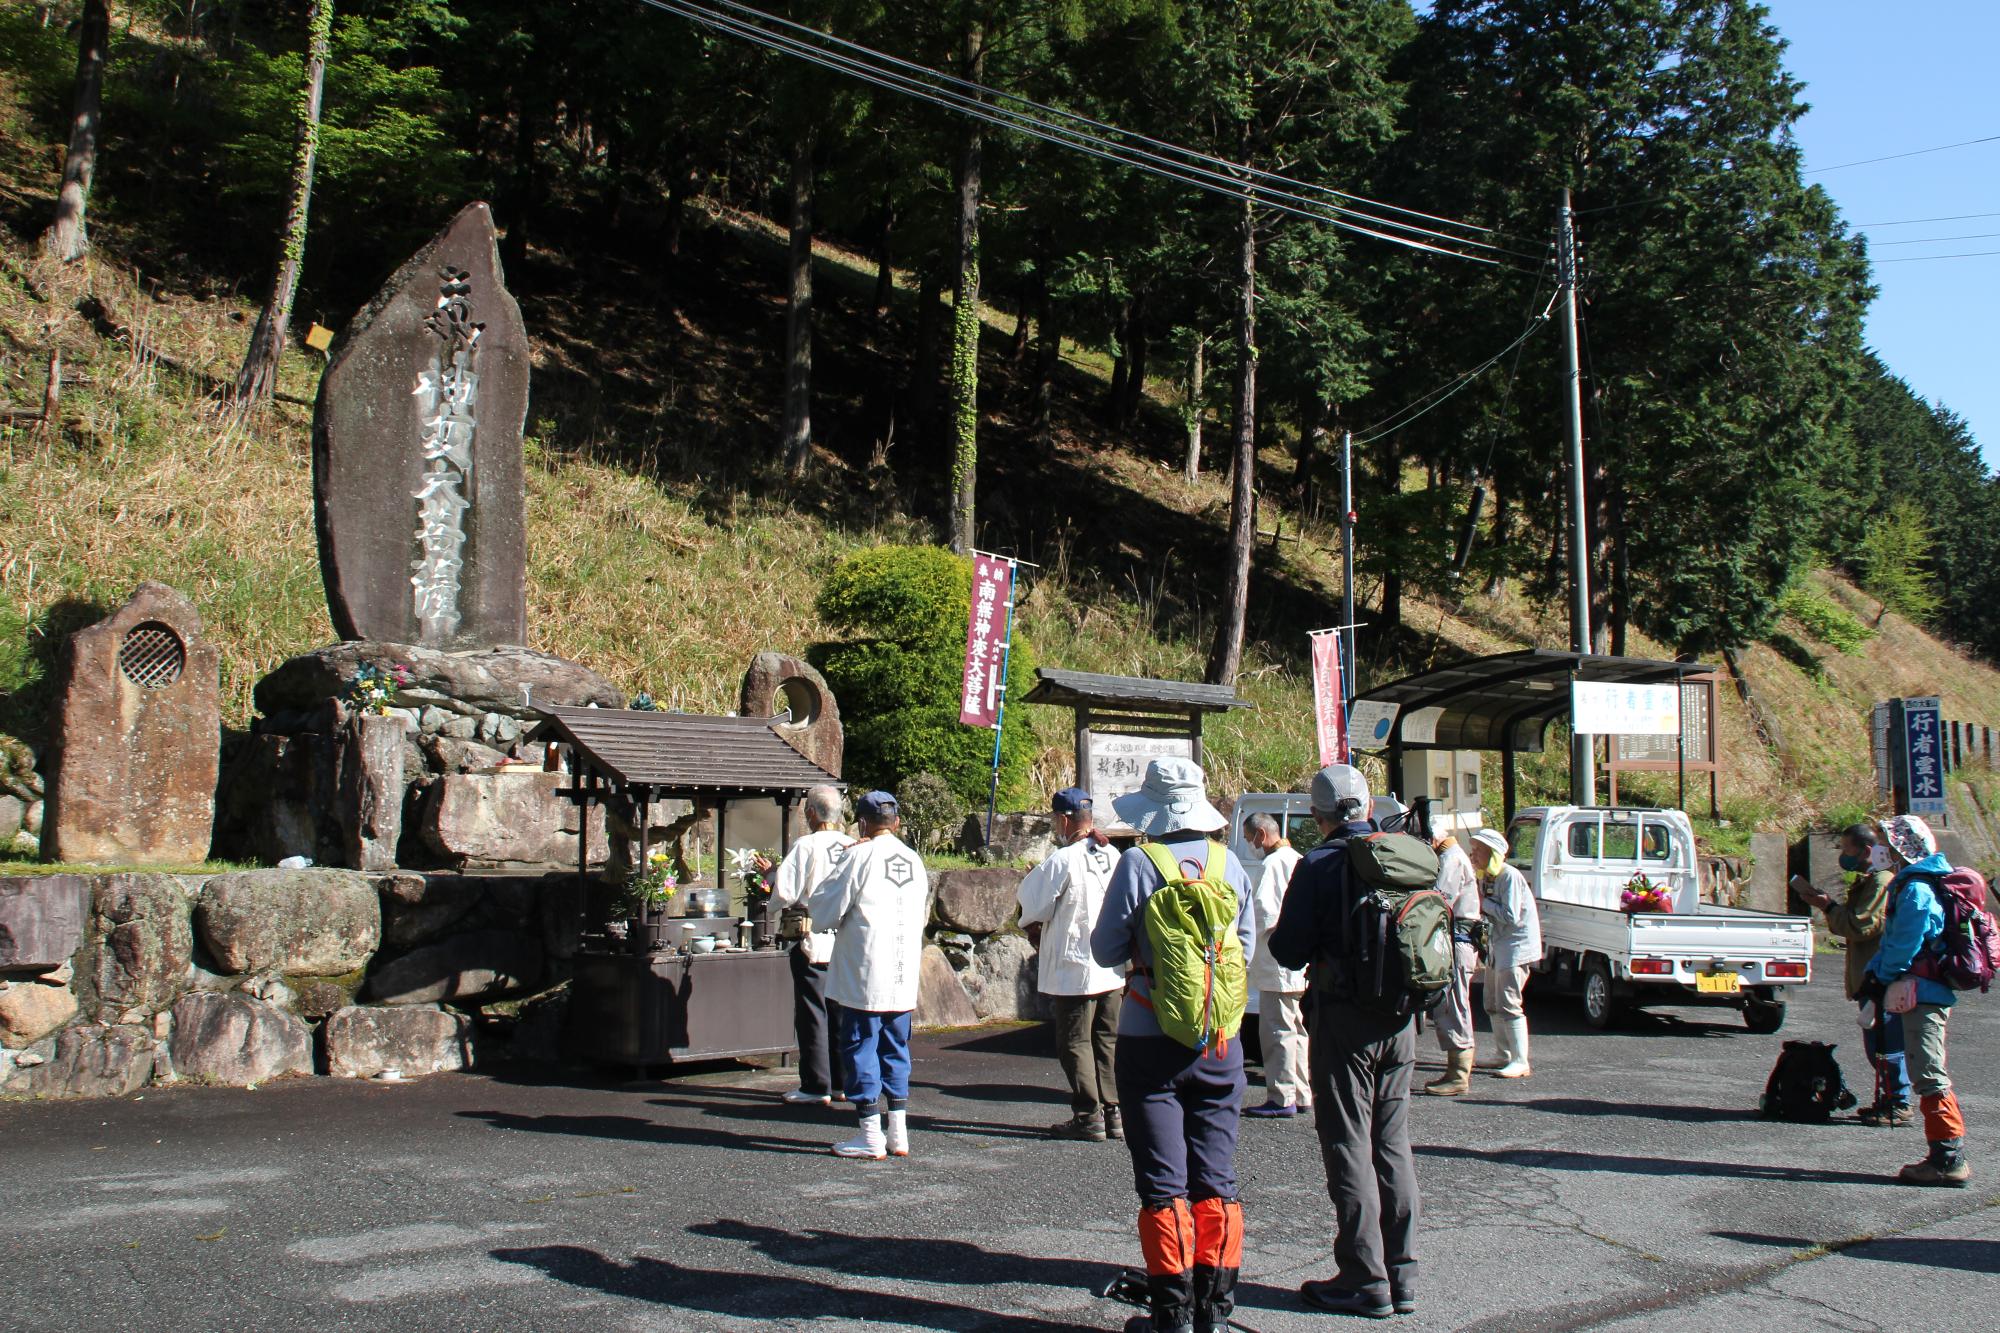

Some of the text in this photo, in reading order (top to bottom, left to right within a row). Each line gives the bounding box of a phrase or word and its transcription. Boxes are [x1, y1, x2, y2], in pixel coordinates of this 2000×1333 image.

[964, 580, 997, 716] 南無神変大菩薩
